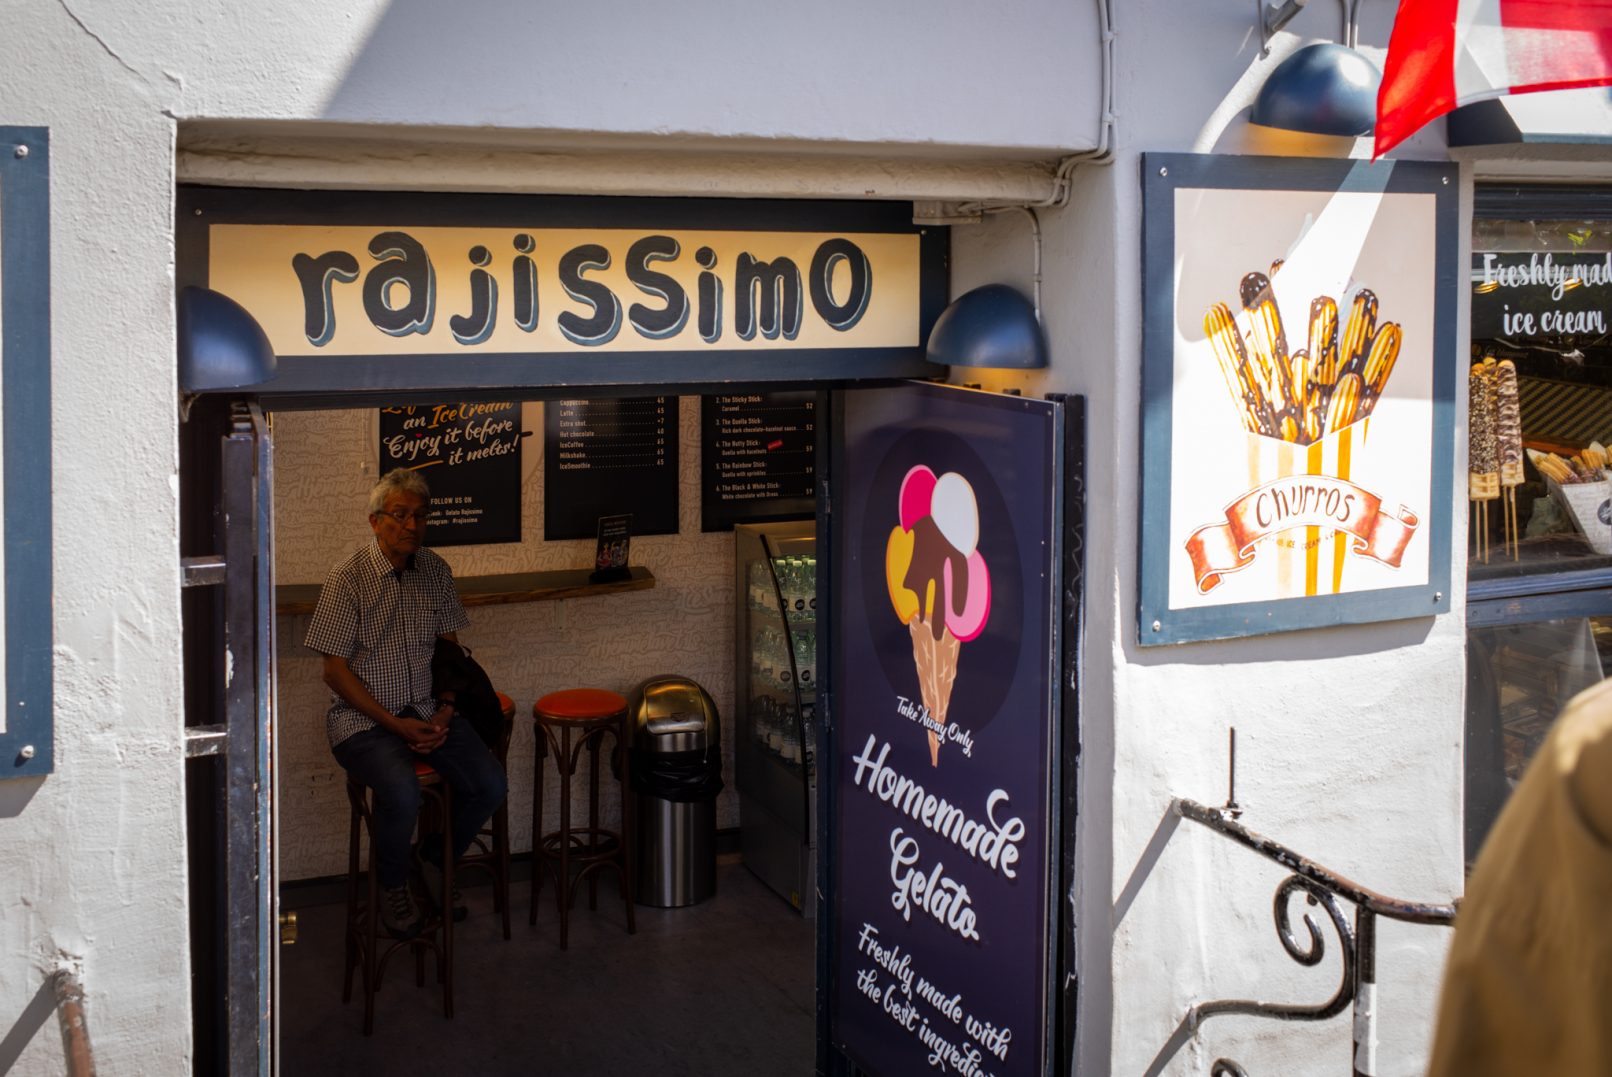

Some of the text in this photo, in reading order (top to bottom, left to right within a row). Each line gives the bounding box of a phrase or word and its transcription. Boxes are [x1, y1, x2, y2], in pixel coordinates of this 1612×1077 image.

[292, 231, 872, 346] rajissimo
[1483, 252, 1612, 301] Freshly mad
[1503, 304, 1607, 336] ice cream
[383, 417, 513, 461] Enjoy it before
[403, 416, 427, 430] an
[427, 404, 457, 429] Ice
[448, 434, 520, 466] it melts!
[430, 496, 472, 505] FOLLOW US ON
[1256, 485, 1355, 528] Churros
[897, 695, 974, 758] Take Away Only
[852, 733, 1025, 878] Homemade
[890, 827, 980, 941] Gelato
[856, 969, 882, 1003] the
[883, 984, 920, 1031] best
[858, 922, 1011, 1061] Freshly made with
